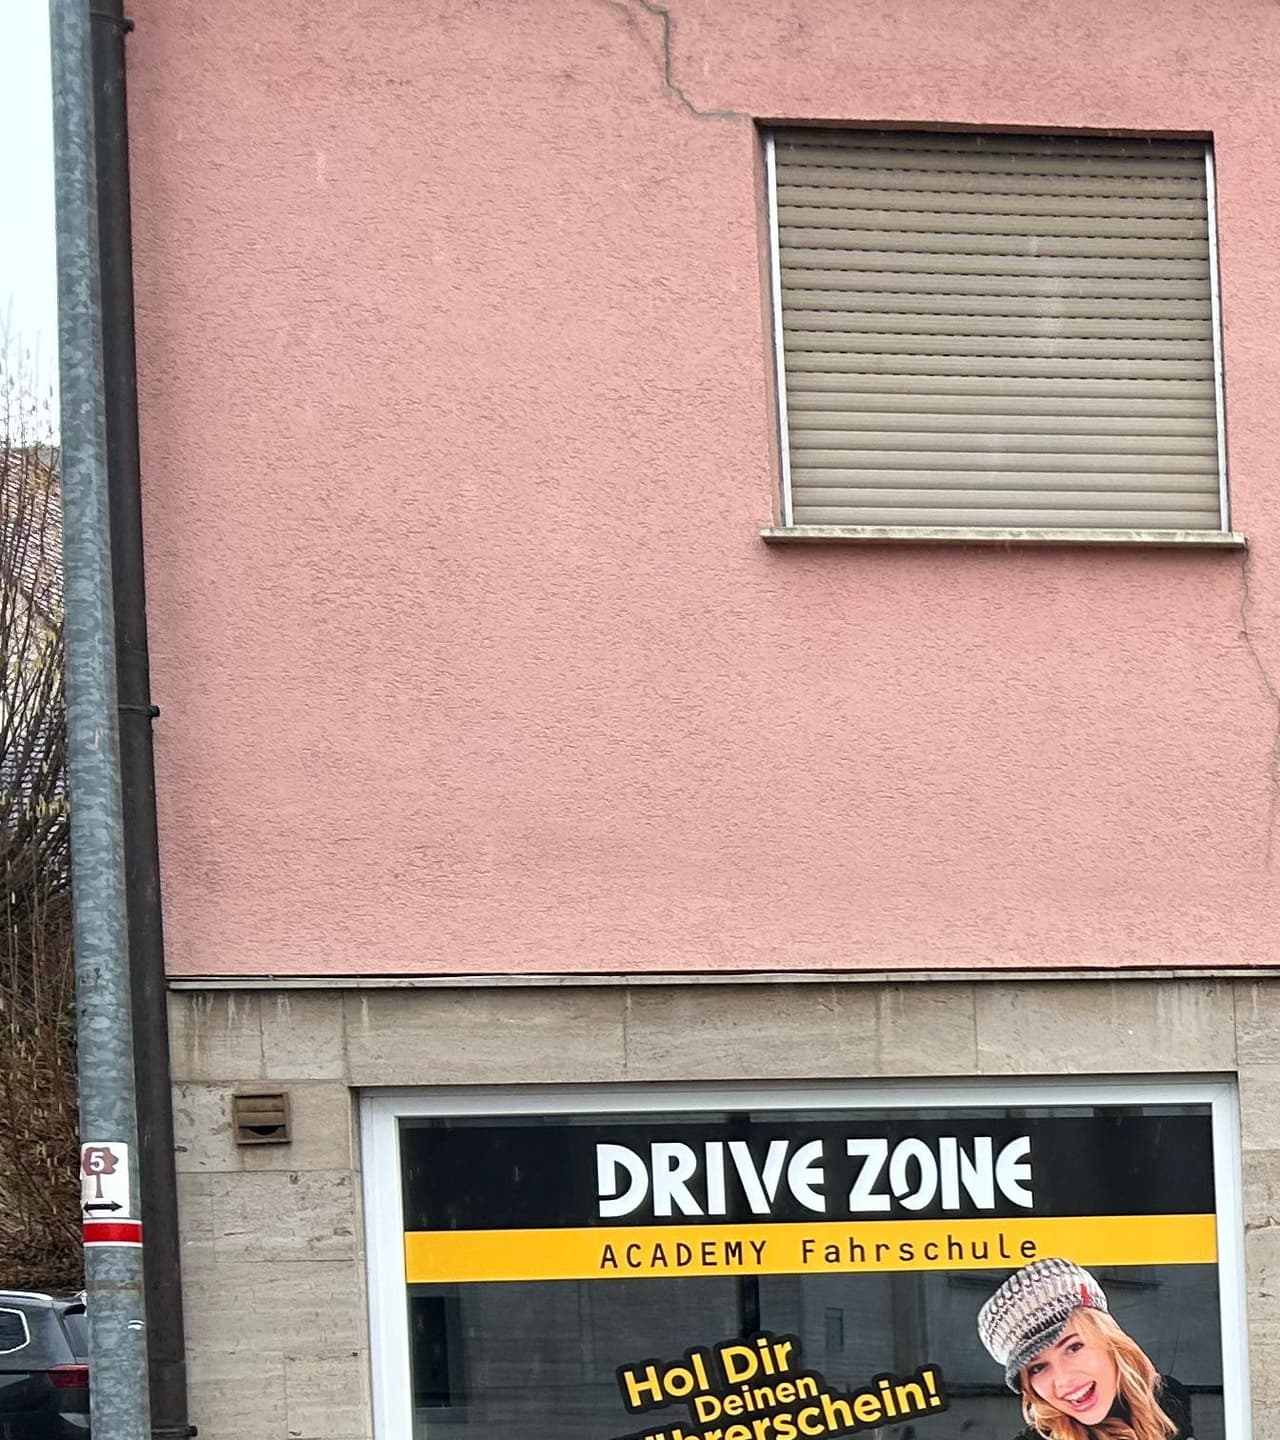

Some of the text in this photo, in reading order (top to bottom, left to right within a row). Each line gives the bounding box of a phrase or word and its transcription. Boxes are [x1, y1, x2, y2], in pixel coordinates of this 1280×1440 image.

[89, 1150, 105, 1173] 5
[597, 1135, 1034, 1218] DRIVE ZONE
[600, 1232, 1038, 1269] ACADEMY Fahrschule
[624, 1338, 793, 1408] Hol Dir
[694, 1376, 819, 1423] Deinen
